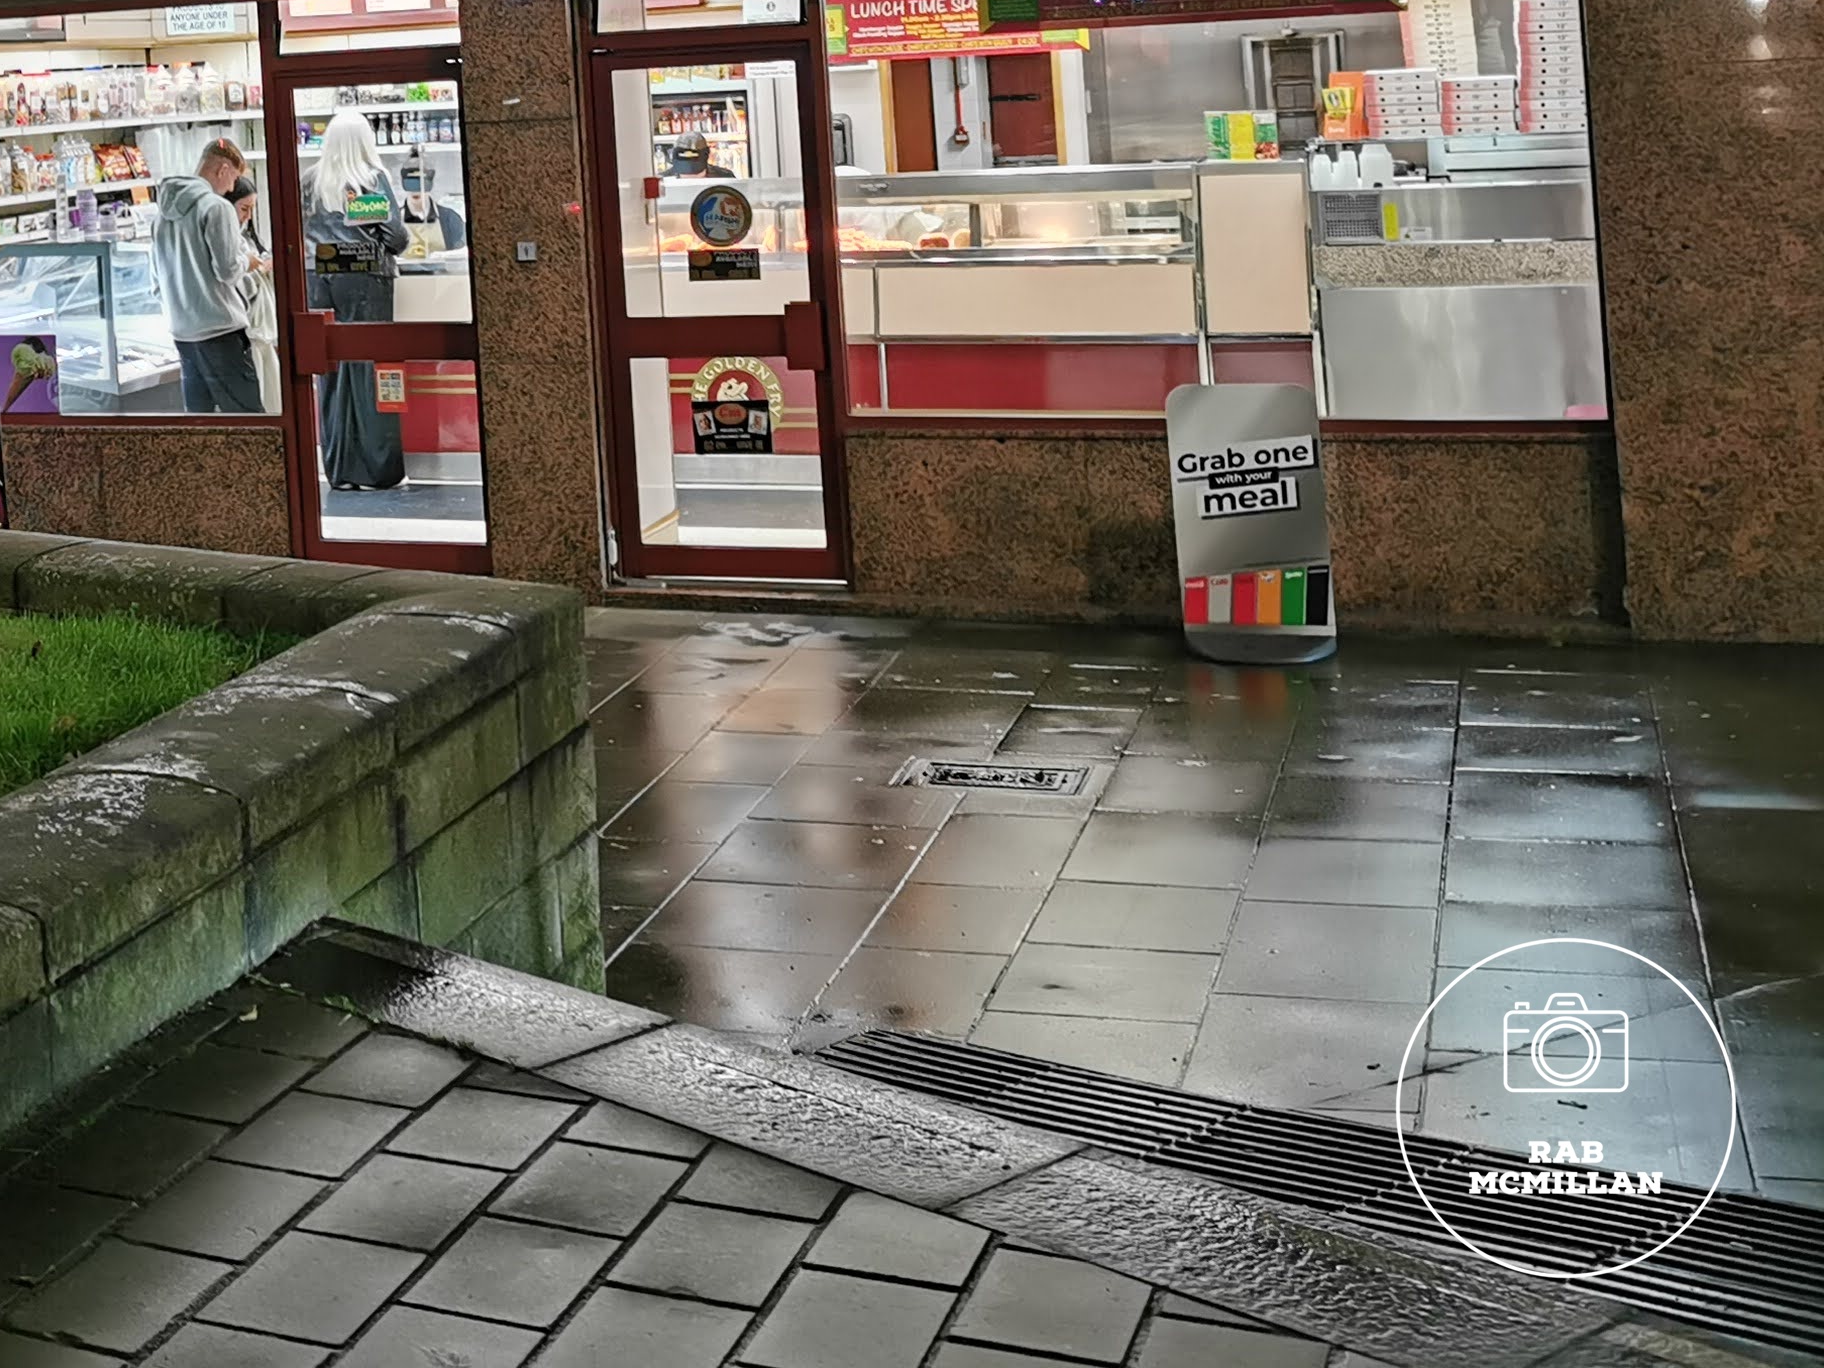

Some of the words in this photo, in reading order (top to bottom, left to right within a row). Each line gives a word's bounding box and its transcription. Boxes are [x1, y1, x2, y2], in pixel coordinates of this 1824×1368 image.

[170, 12, 200, 22] ANYONE
[203, 11, 228, 21] UNDER
[850, 0, 906, 19] LUNCH
[173, 22, 188, 31] THE
[190, 21, 204, 30] AGE
[206, 21, 216, 30] OF
[703, 356, 771, 380] GOLDEN
[767, 383, 782, 418] FRY
[1177, 447, 1245, 474] Grab
[1254, 444, 1309, 465] one
[1214, 473, 1243, 485] with
[1245, 470, 1272, 484] your
[1203, 479, 1288, 513] meal
